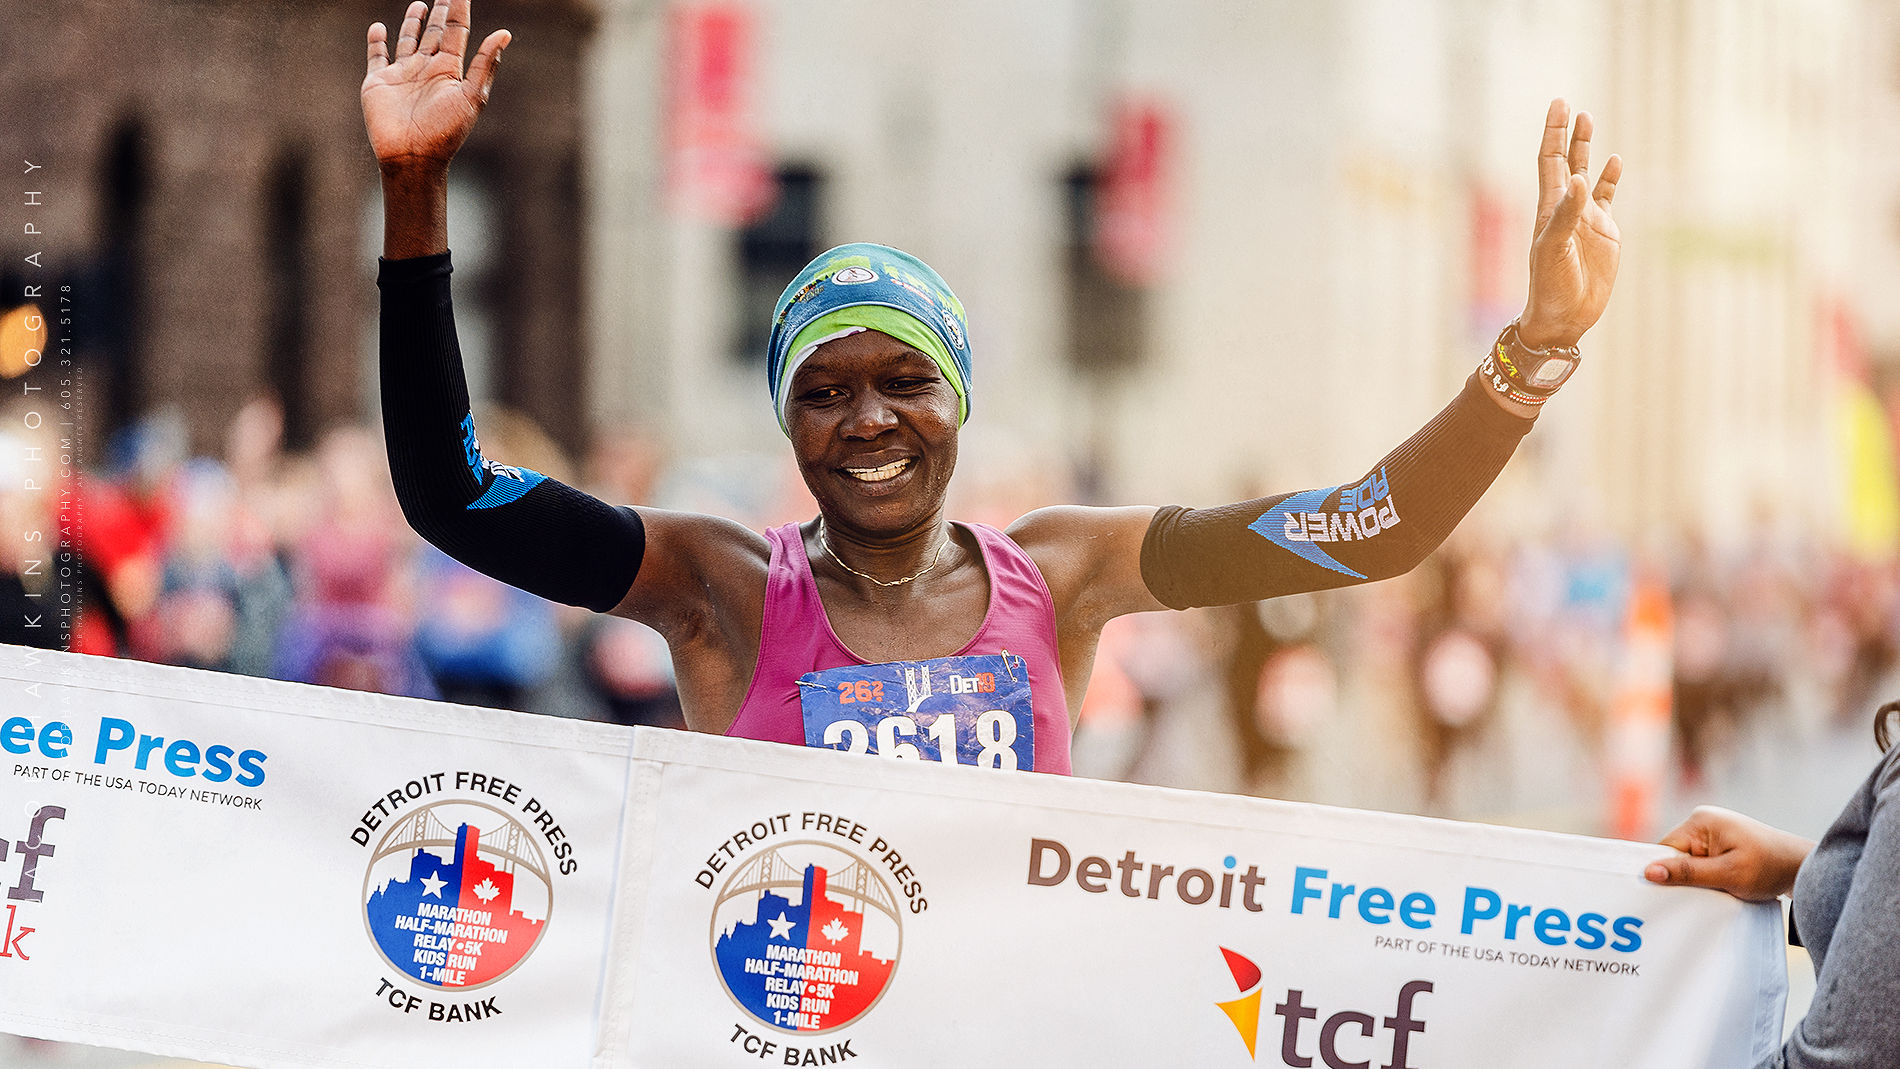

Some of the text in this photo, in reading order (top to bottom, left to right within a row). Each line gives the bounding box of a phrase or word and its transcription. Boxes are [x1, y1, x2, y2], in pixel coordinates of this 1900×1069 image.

[1338, 466, 1390, 512] ADE
[1283, 494, 1401, 543] POWER
[94, 716, 268, 788] Press
[13, 764, 262, 811] PART OF THE USA TODAY NETWORK
[350, 771, 578, 876] DETROIT FREE PRESS
[0, 805, 66, 903] f
[694, 812, 928, 914] DETROIT FREE PRESS
[417, 902, 492, 926] MARATHON
[1027, 838, 1644, 953] Detroit Free Press
[394, 915, 508, 944] HALF-MARATHON
[413, 949, 477, 971] KIDS RUN
[420, 966, 466, 985] 1-MILE
[744, 958, 860, 986] HALF-MARATHON
[766, 944, 842, 968] MARATHON
[1374, 935, 1641, 976] PART OF THE USA TODAY NETWORK
[375, 977, 502, 1022] TCF BANK
[766, 992, 830, 1014] KIDS RUN
[774, 1010, 820, 1030] 1-MILE
[730, 1023, 858, 1068] TCF BANK
[1275, 980, 1434, 1069] tcf
